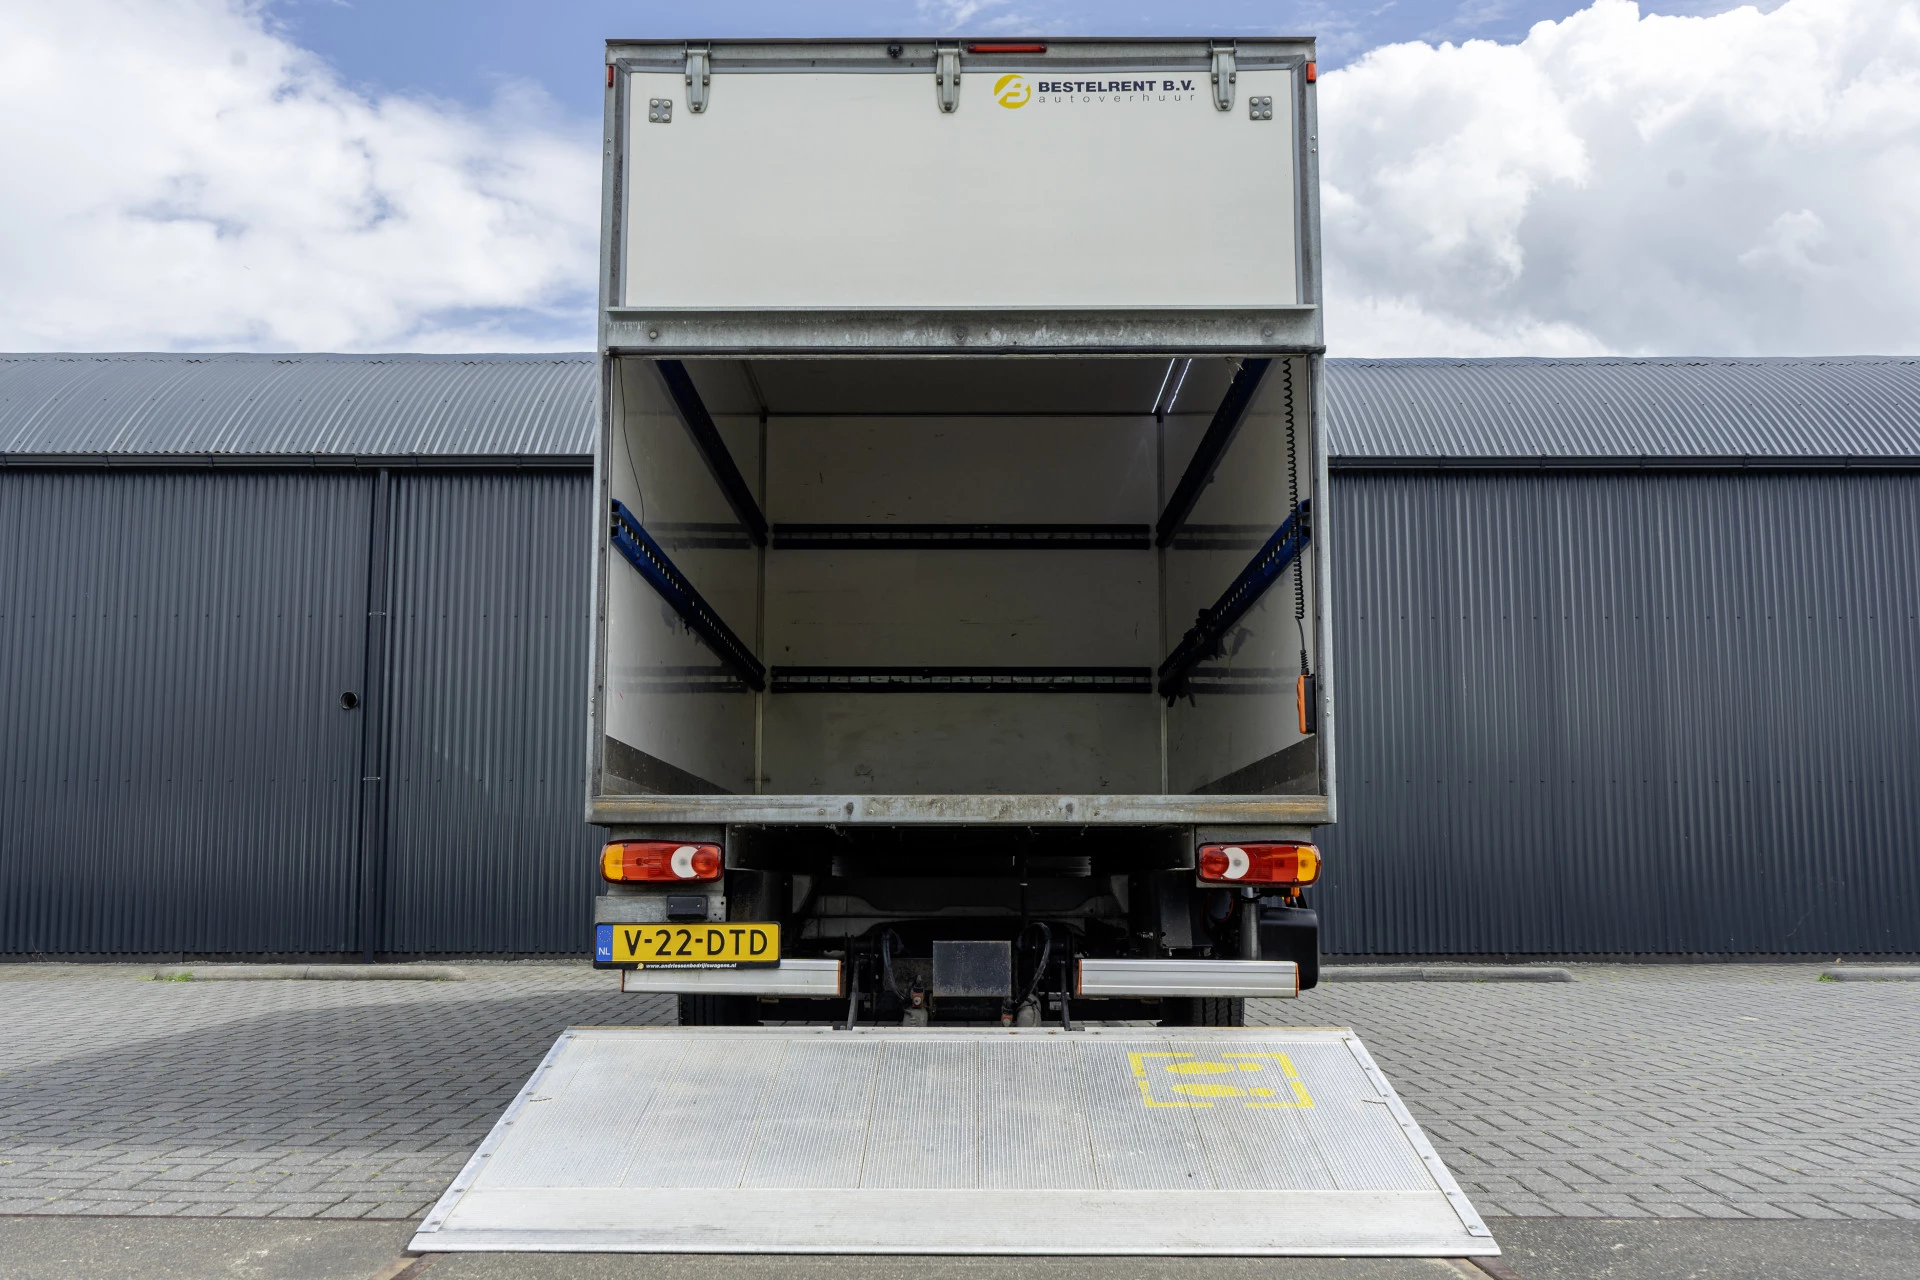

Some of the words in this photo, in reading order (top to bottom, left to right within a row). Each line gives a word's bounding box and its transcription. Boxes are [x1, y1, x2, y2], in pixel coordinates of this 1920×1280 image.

[1038, 80, 1156, 93] BESTELRENT
[1163, 80, 1195, 91] B.V.
[1039, 93, 1195, 103] autoverhuur
[624, 929, 768, 956] V-22-DTD
[598, 947, 611, 956] NL
